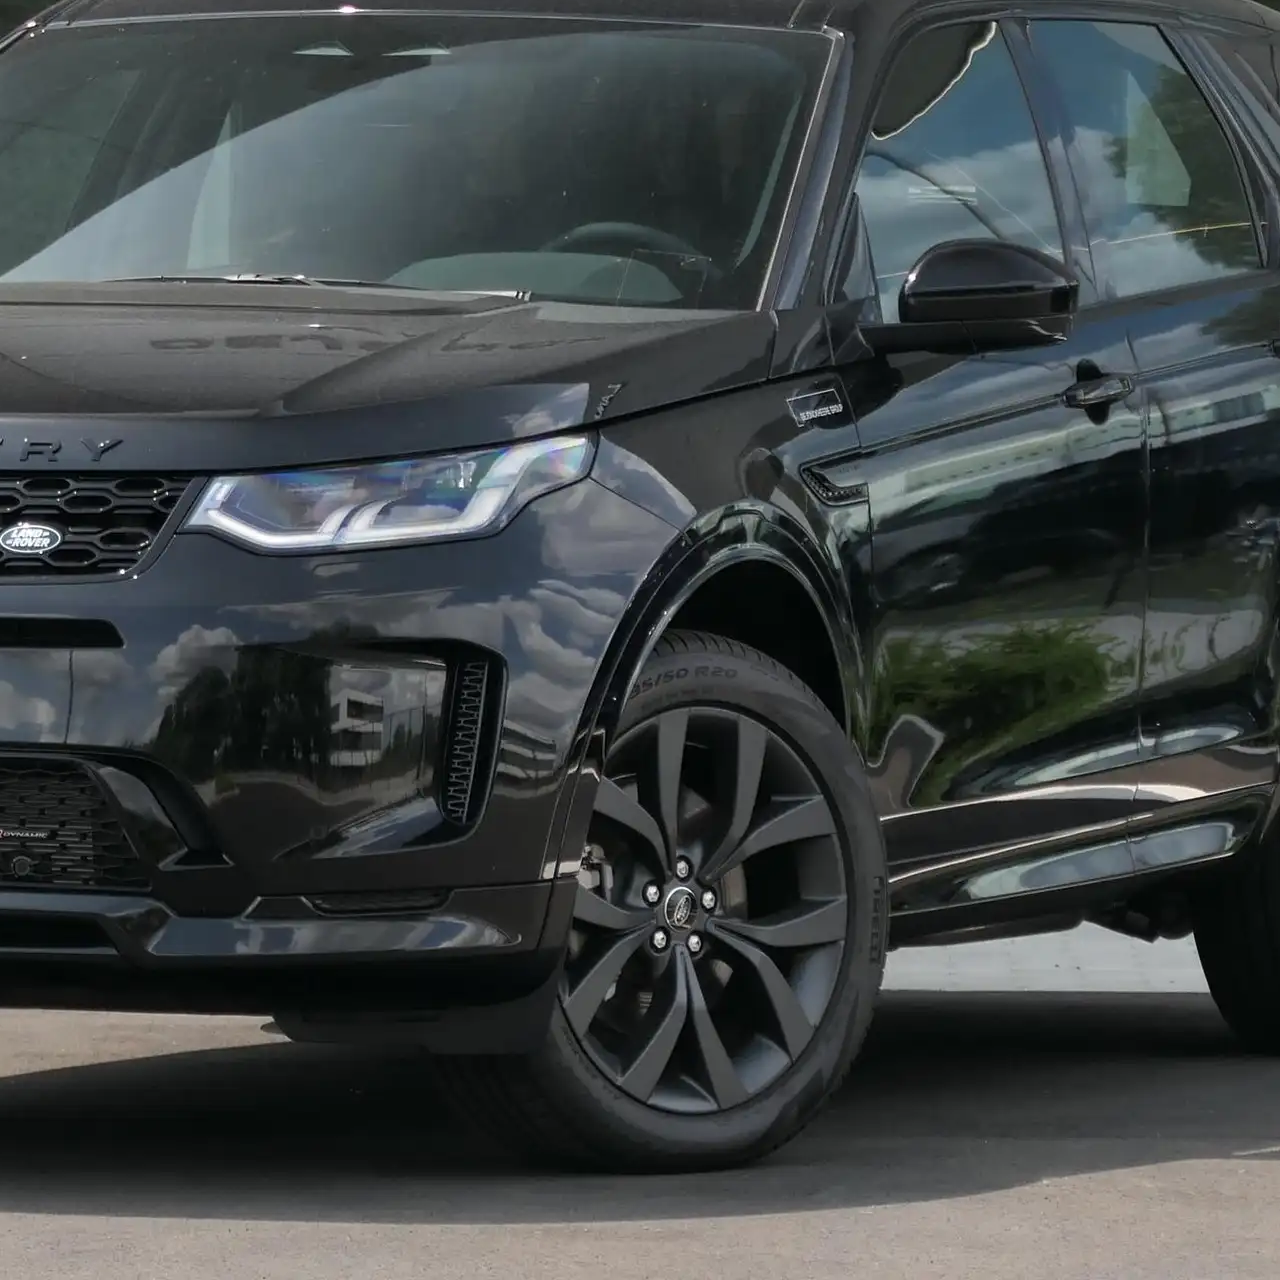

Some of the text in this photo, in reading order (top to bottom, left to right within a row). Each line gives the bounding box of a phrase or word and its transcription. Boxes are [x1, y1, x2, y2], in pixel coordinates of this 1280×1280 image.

[11, 529, 43, 538] LAND
[12, 538, 50, 547] ROVER
[694, 665, 738, 679] R20
